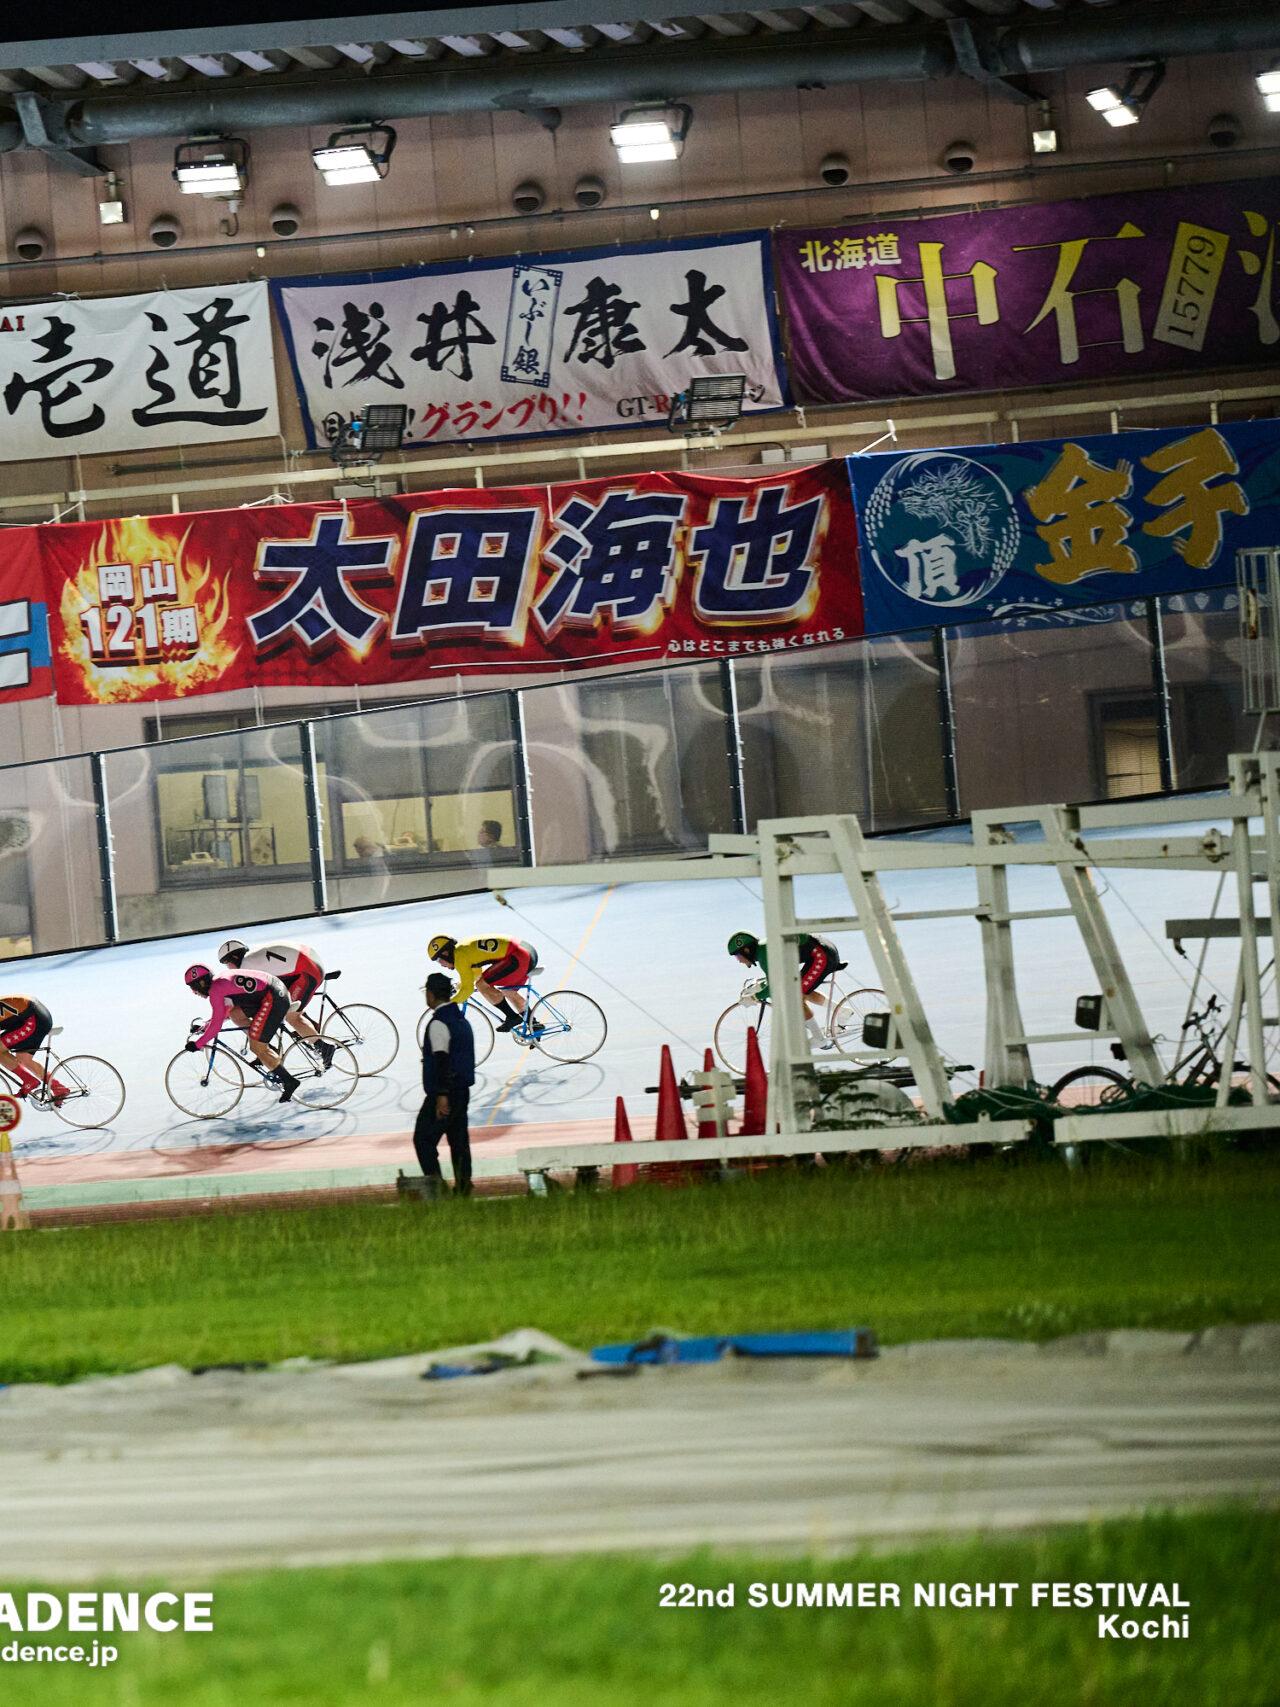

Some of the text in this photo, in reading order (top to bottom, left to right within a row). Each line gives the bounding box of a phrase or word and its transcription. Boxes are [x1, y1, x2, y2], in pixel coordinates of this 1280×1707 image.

[799, 233, 902, 274] 北海道
[874, 222, 1146, 380] 中石
[1167, 234, 1217, 342] 15779
[312, 269, 749, 389] 浅井 康太
[3, 297, 269, 438] 壱道
[1024, 427, 1250, 585] 金子
[97, 559, 178, 604] 岡山
[245, 484, 828, 650] 太田海也
[894, 533, 961, 599] 頂
[79, 602, 200, 656] 121期
[265, 950, 287, 963] 1
[431, 940, 440, 952] 5
[477, 938, 499, 953] 5
[190, 968, 198, 979] 8
[234, 974, 258, 993] 8
